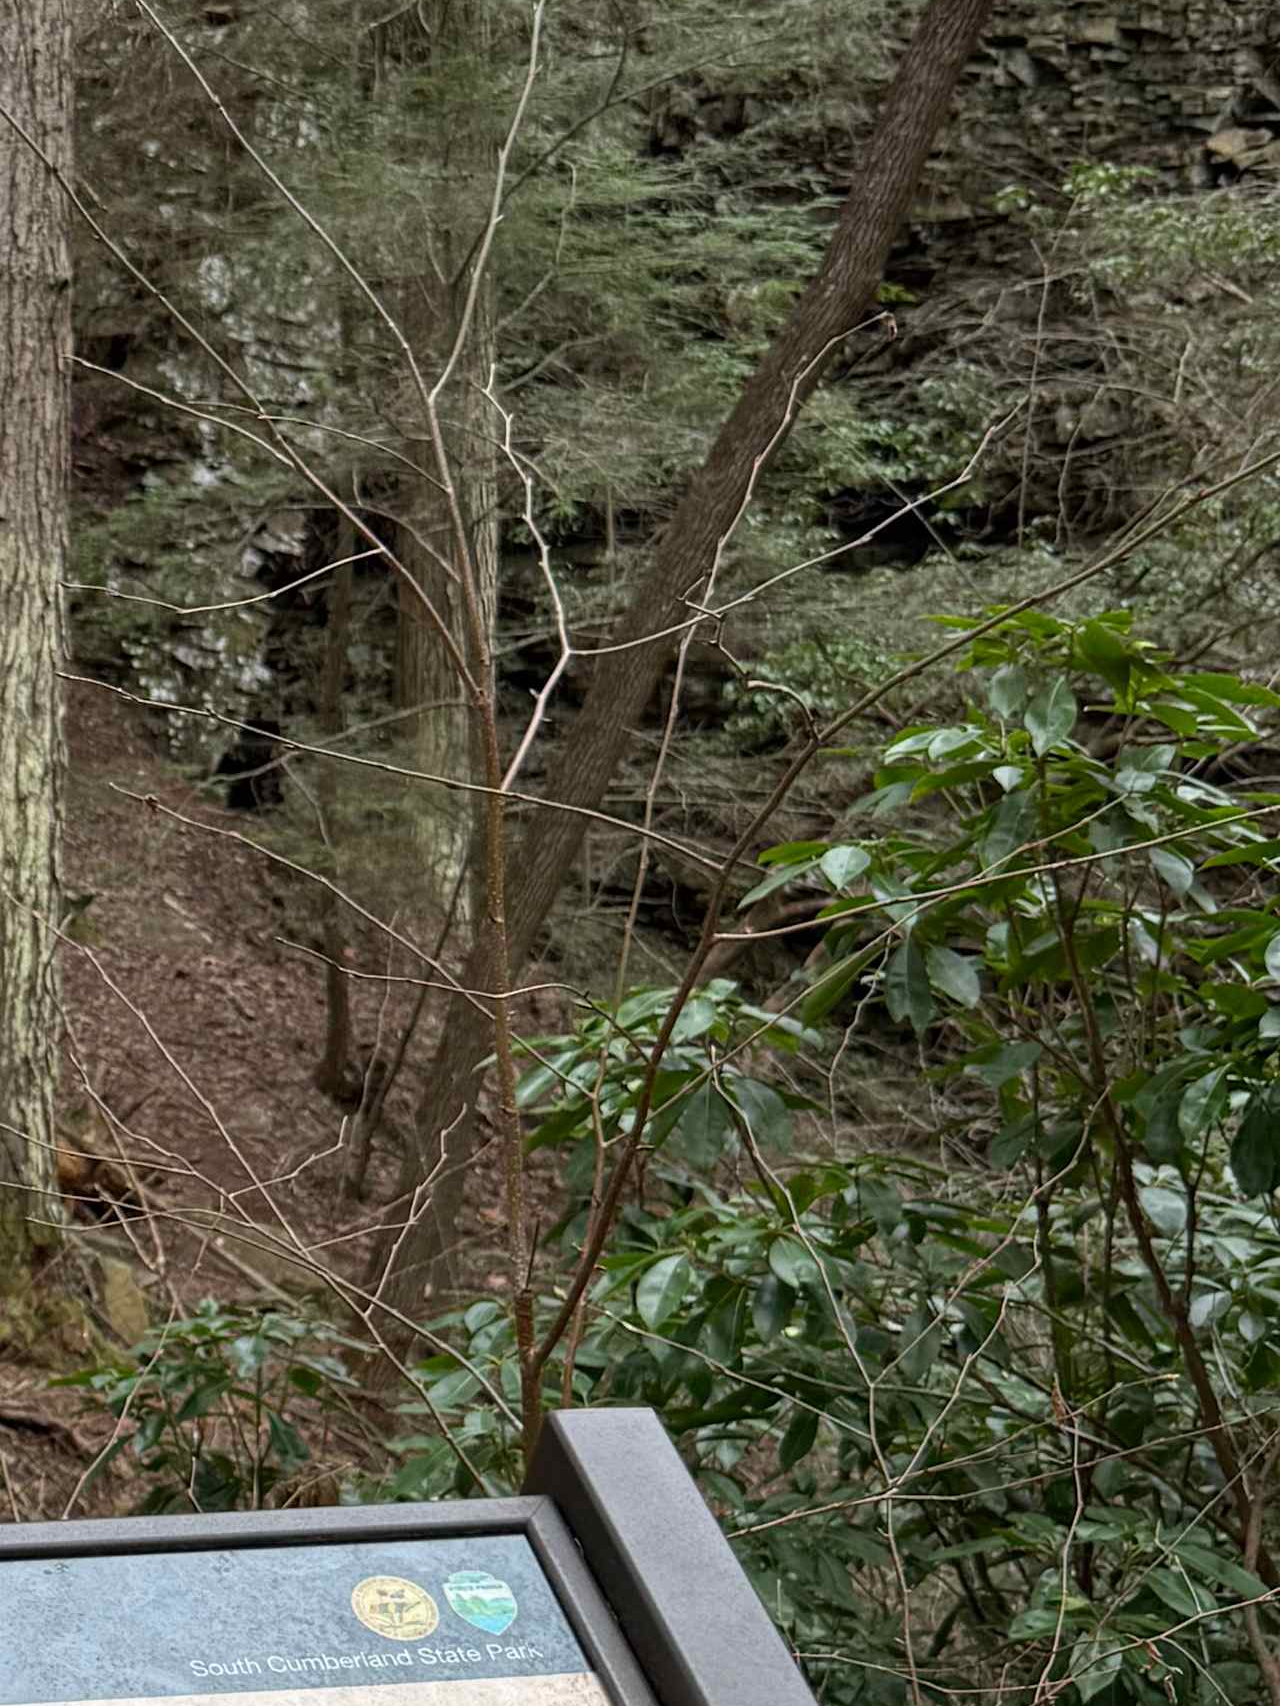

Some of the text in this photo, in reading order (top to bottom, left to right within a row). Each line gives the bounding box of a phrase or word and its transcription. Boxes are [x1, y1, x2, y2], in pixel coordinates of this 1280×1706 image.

[189, 1641, 544, 1677] South Cumberland State Park
